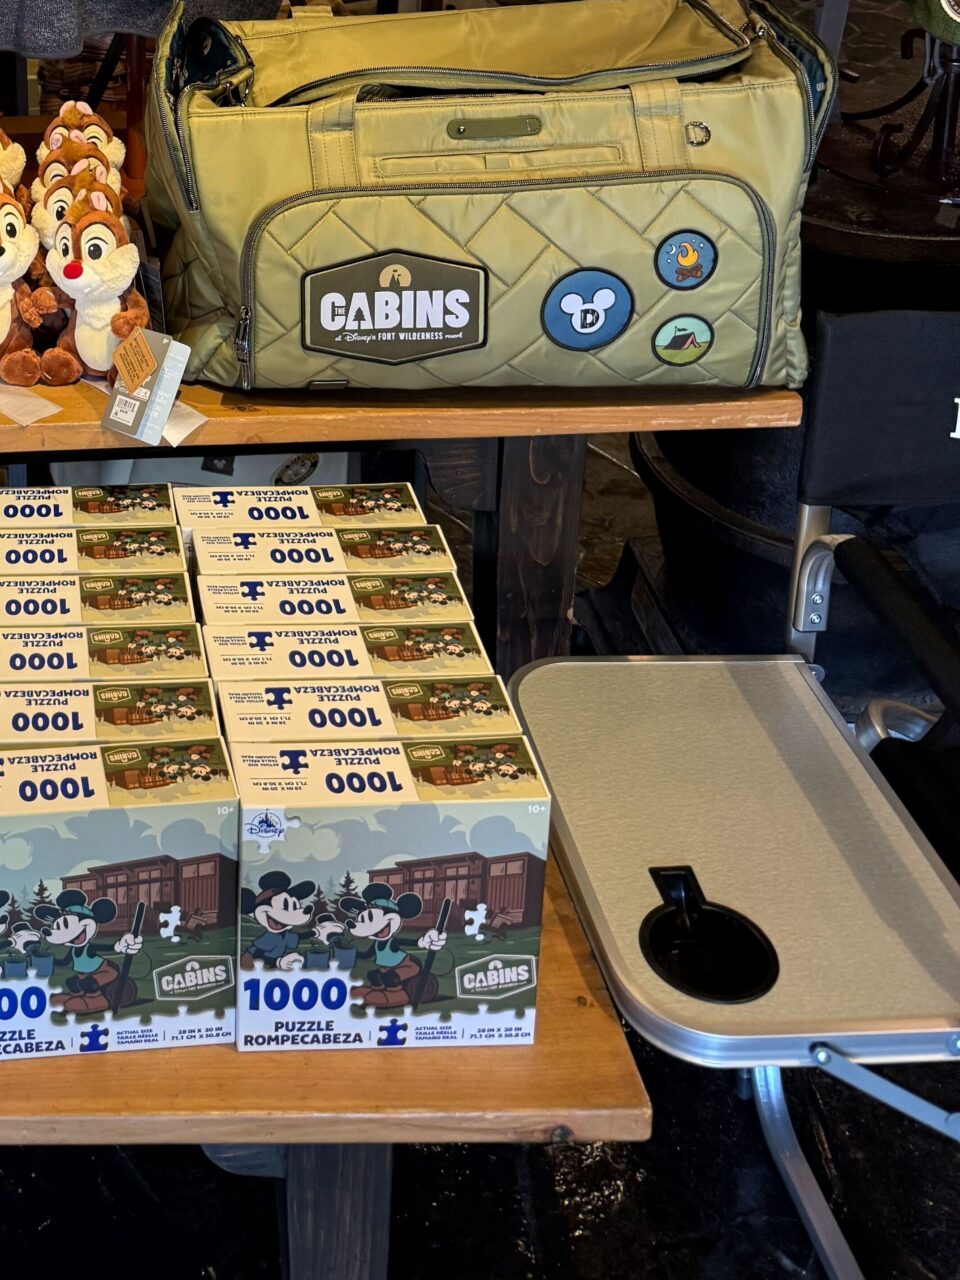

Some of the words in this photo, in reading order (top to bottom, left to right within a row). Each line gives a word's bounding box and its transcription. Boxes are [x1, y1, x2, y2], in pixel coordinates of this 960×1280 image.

[320, 288, 470, 331] CABINS
[335, 307, 346, 315] THE
[334, 334, 341, 342] at
[343, 331, 377, 344] Disney's
[377, 332, 396, 341] FORT
[398, 331, 444, 341] WILDERNESS
[3, 503, 64, 518] 1000
[248, 506, 310, 521] 1000
[5, 549, 68, 564] 1000
[269, 548, 335, 564] 1000
[266, 579, 346, 587] ROMPECABEZA
[5, 598, 71, 615] 1000
[279, 598, 347, 616] 1000
[2, 631, 84, 640] ROMPECABEZA
[275, 629, 358, 638] ROMPECABEZA
[297, 637, 339, 645] PUZZLE
[9, 652, 78, 670] 1000
[288, 648, 360, 668] 1000
[3, 689, 90, 697] ROMPECABEZA
[292, 684, 380, 694] ROMPECABEZA
[25, 697, 69, 706] PUZZLE
[316, 693, 361, 702] PUZZLE
[11, 711, 84, 732] 1000
[307, 707, 383, 728] 1000
[7, 752, 98, 764] ROMPECABEZA
[309, 746, 401, 758] ROMPECABEZA
[31, 763, 77, 773] PUZZLE
[334, 756, 381, 766] PUZZLE
[17, 775, 96, 802] 1000
[324, 770, 404, 794] 1000
[216, 805, 235, 816] 10+
[528, 804, 547, 814] 10+
[245, 822, 285, 838] Disney
[161, 964, 227, 991] CABINS
[463, 964, 530, 989] CABINS
[243, 977, 348, 1011] 1000
[274, 1020, 335, 1033] PUZZLE
[243, 1032, 363, 1046] ROMPECABEZA
